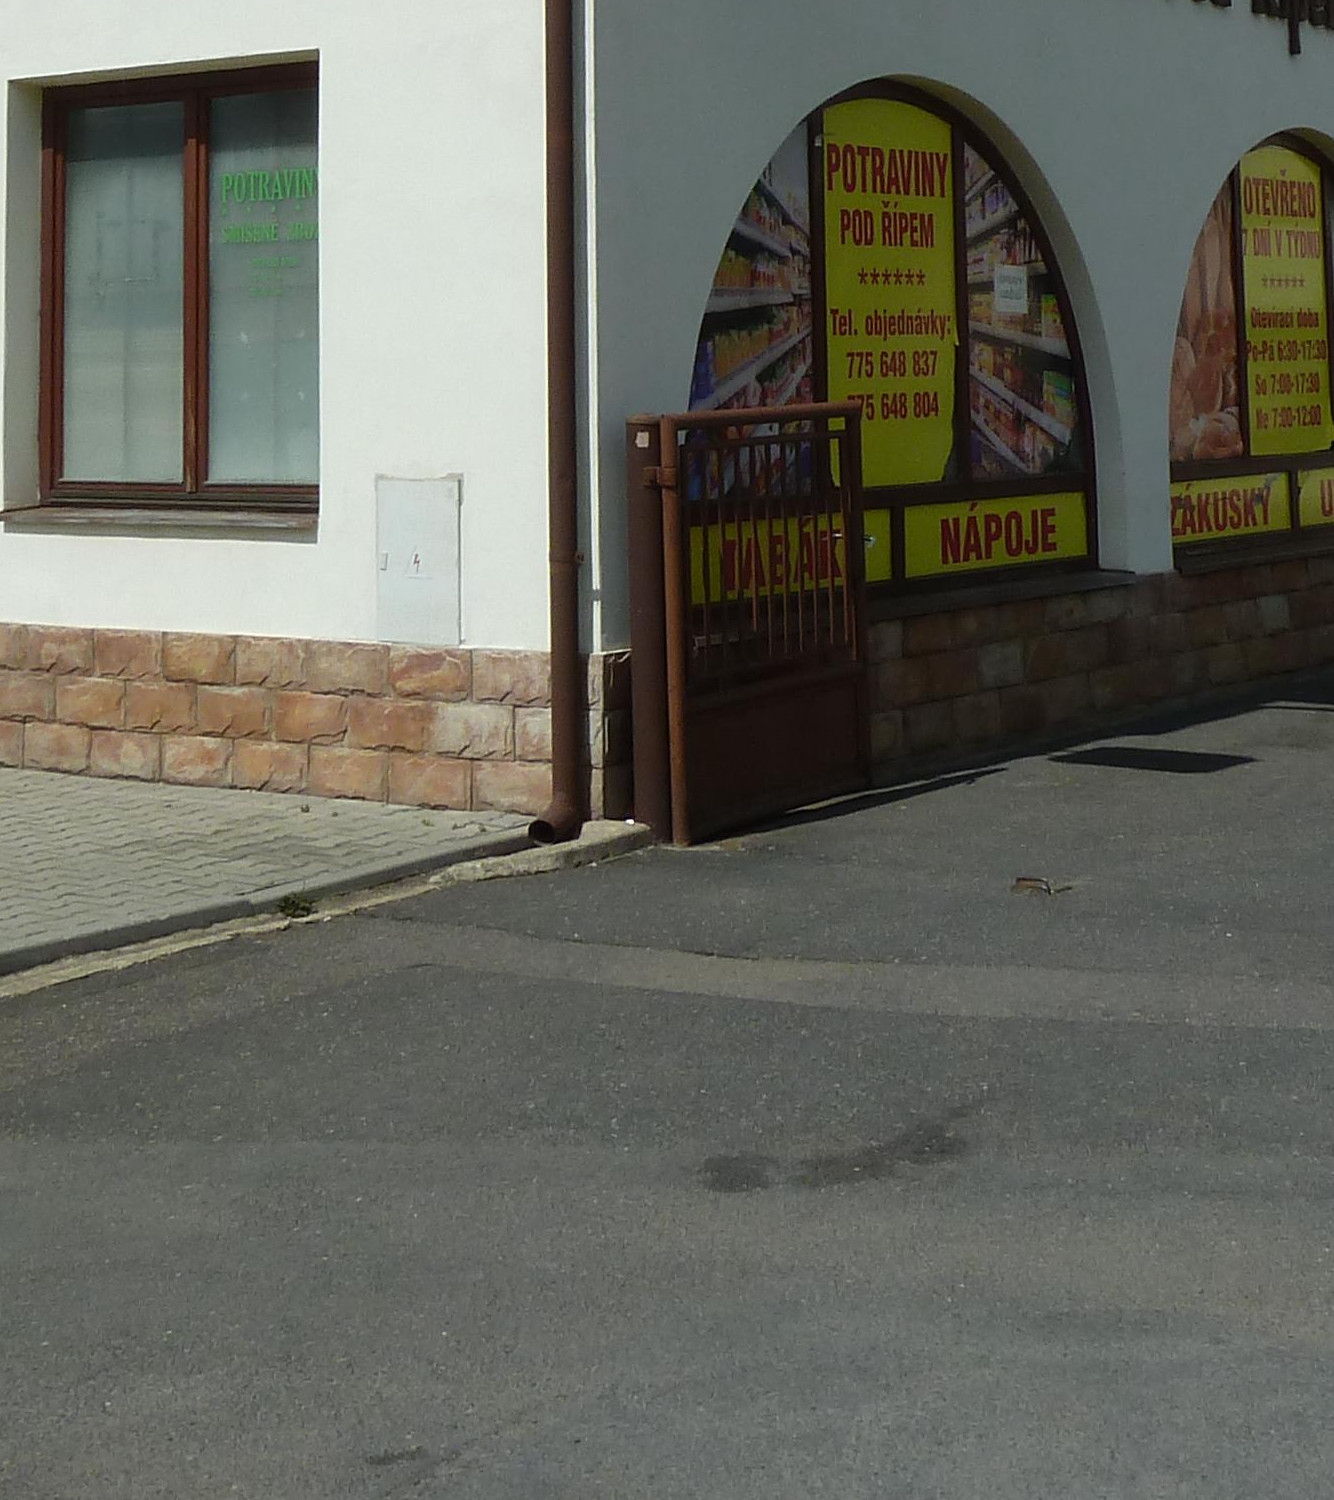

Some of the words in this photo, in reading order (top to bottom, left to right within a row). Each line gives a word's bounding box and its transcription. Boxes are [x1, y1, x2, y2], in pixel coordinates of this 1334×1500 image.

[825, 142, 950, 199] POTRAVINY
[1243, 168, 1316, 219] OTEVŘENO
[839, 207, 875, 247] POD
[881, 200, 936, 249] ŘÍPEM
[1275, 228, 1283, 257] V
[830, 308, 858, 336] Tel.
[865, 308, 952, 341] objednávky:
[846, 351, 875, 379] 775
[879, 350, 907, 378] 648
[912, 350, 938, 377] 837
[881, 392, 908, 420] 648
[913, 391, 939, 418] 804
[939, 501, 1058, 565] NÁPOJE
[1170, 483, 1272, 536] ZÁKUSKY
